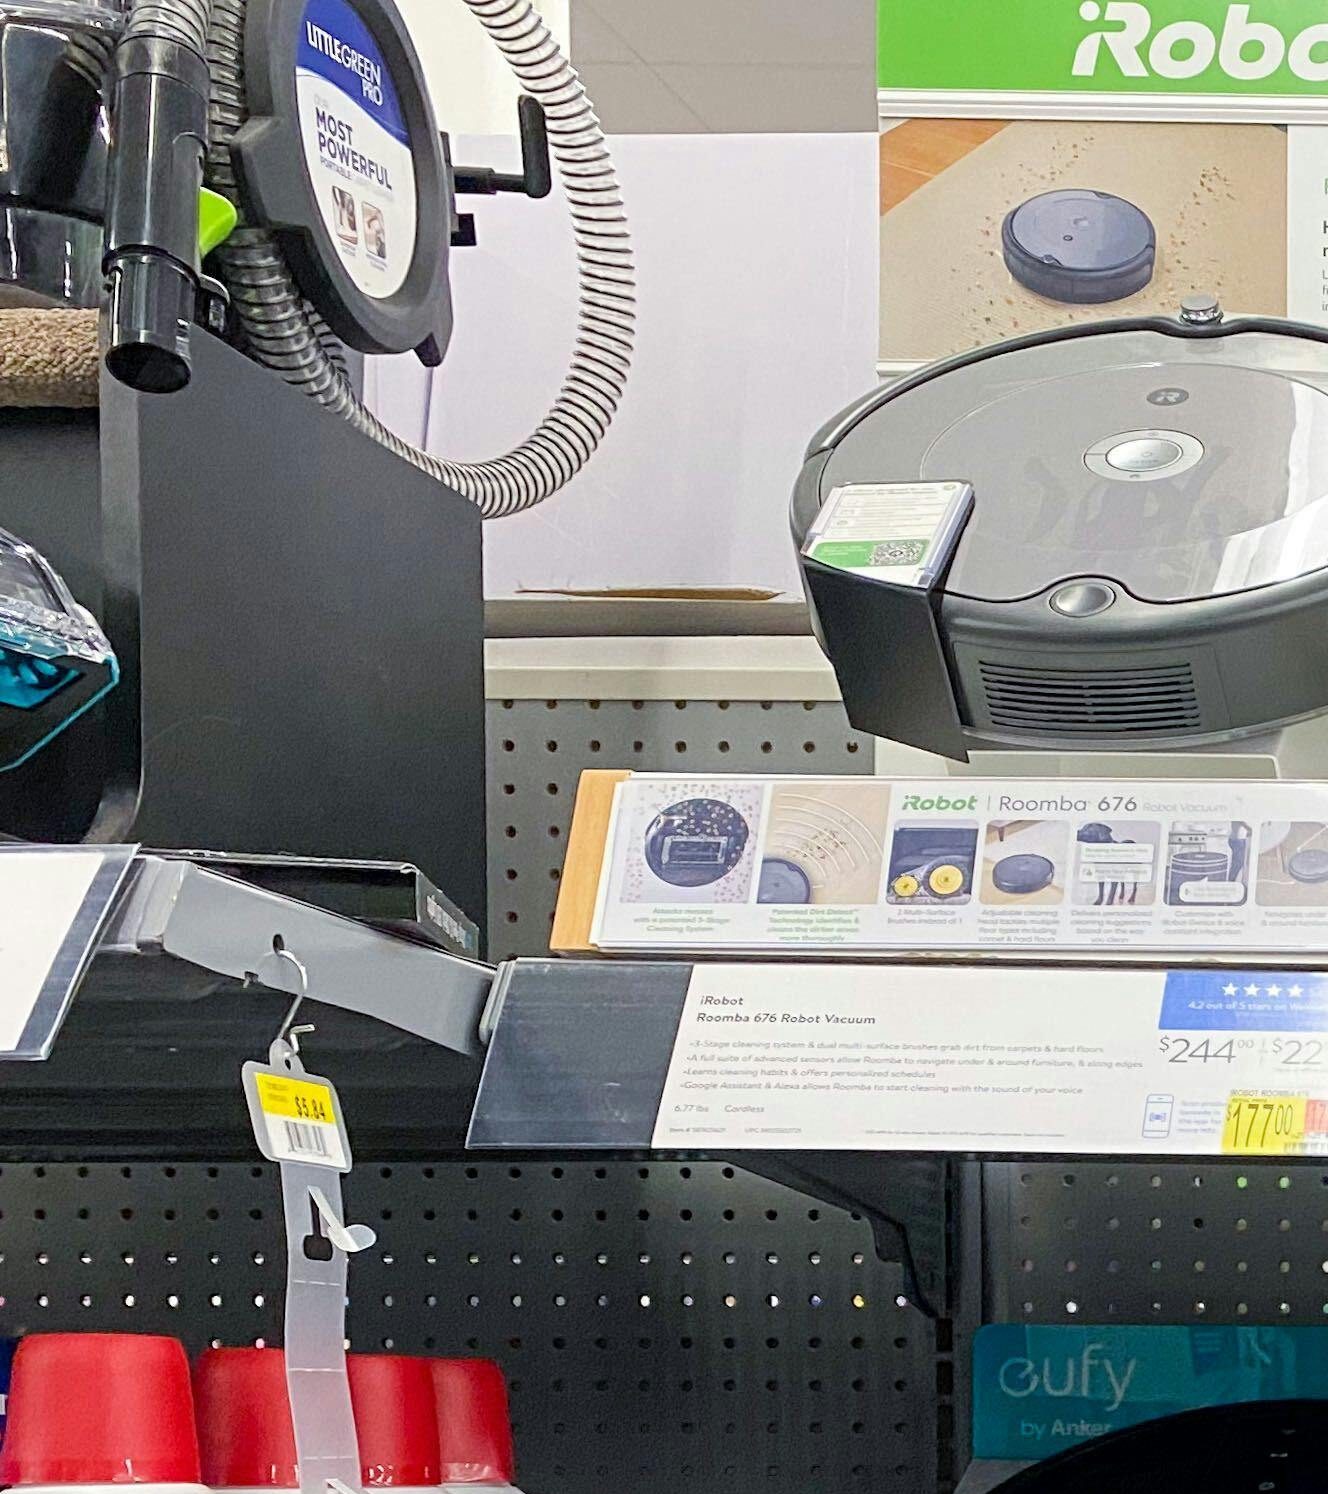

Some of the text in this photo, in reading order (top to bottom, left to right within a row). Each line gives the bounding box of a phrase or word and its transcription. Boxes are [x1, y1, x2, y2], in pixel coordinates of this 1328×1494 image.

[362, 79, 383, 106] PRO
[316, 107, 353, 146] MOST
[318, 132, 392, 190] POWERFUL
[902, 795, 1138, 813] iRobot Roomba 676
[701, 996, 743, 1005] iRobot
[697, 1013, 875, 1024] Roomba 676 Robot Vacuum
[1000, 1344, 1136, 1411] eufy
[1021, 1422, 1043, 1439] by
